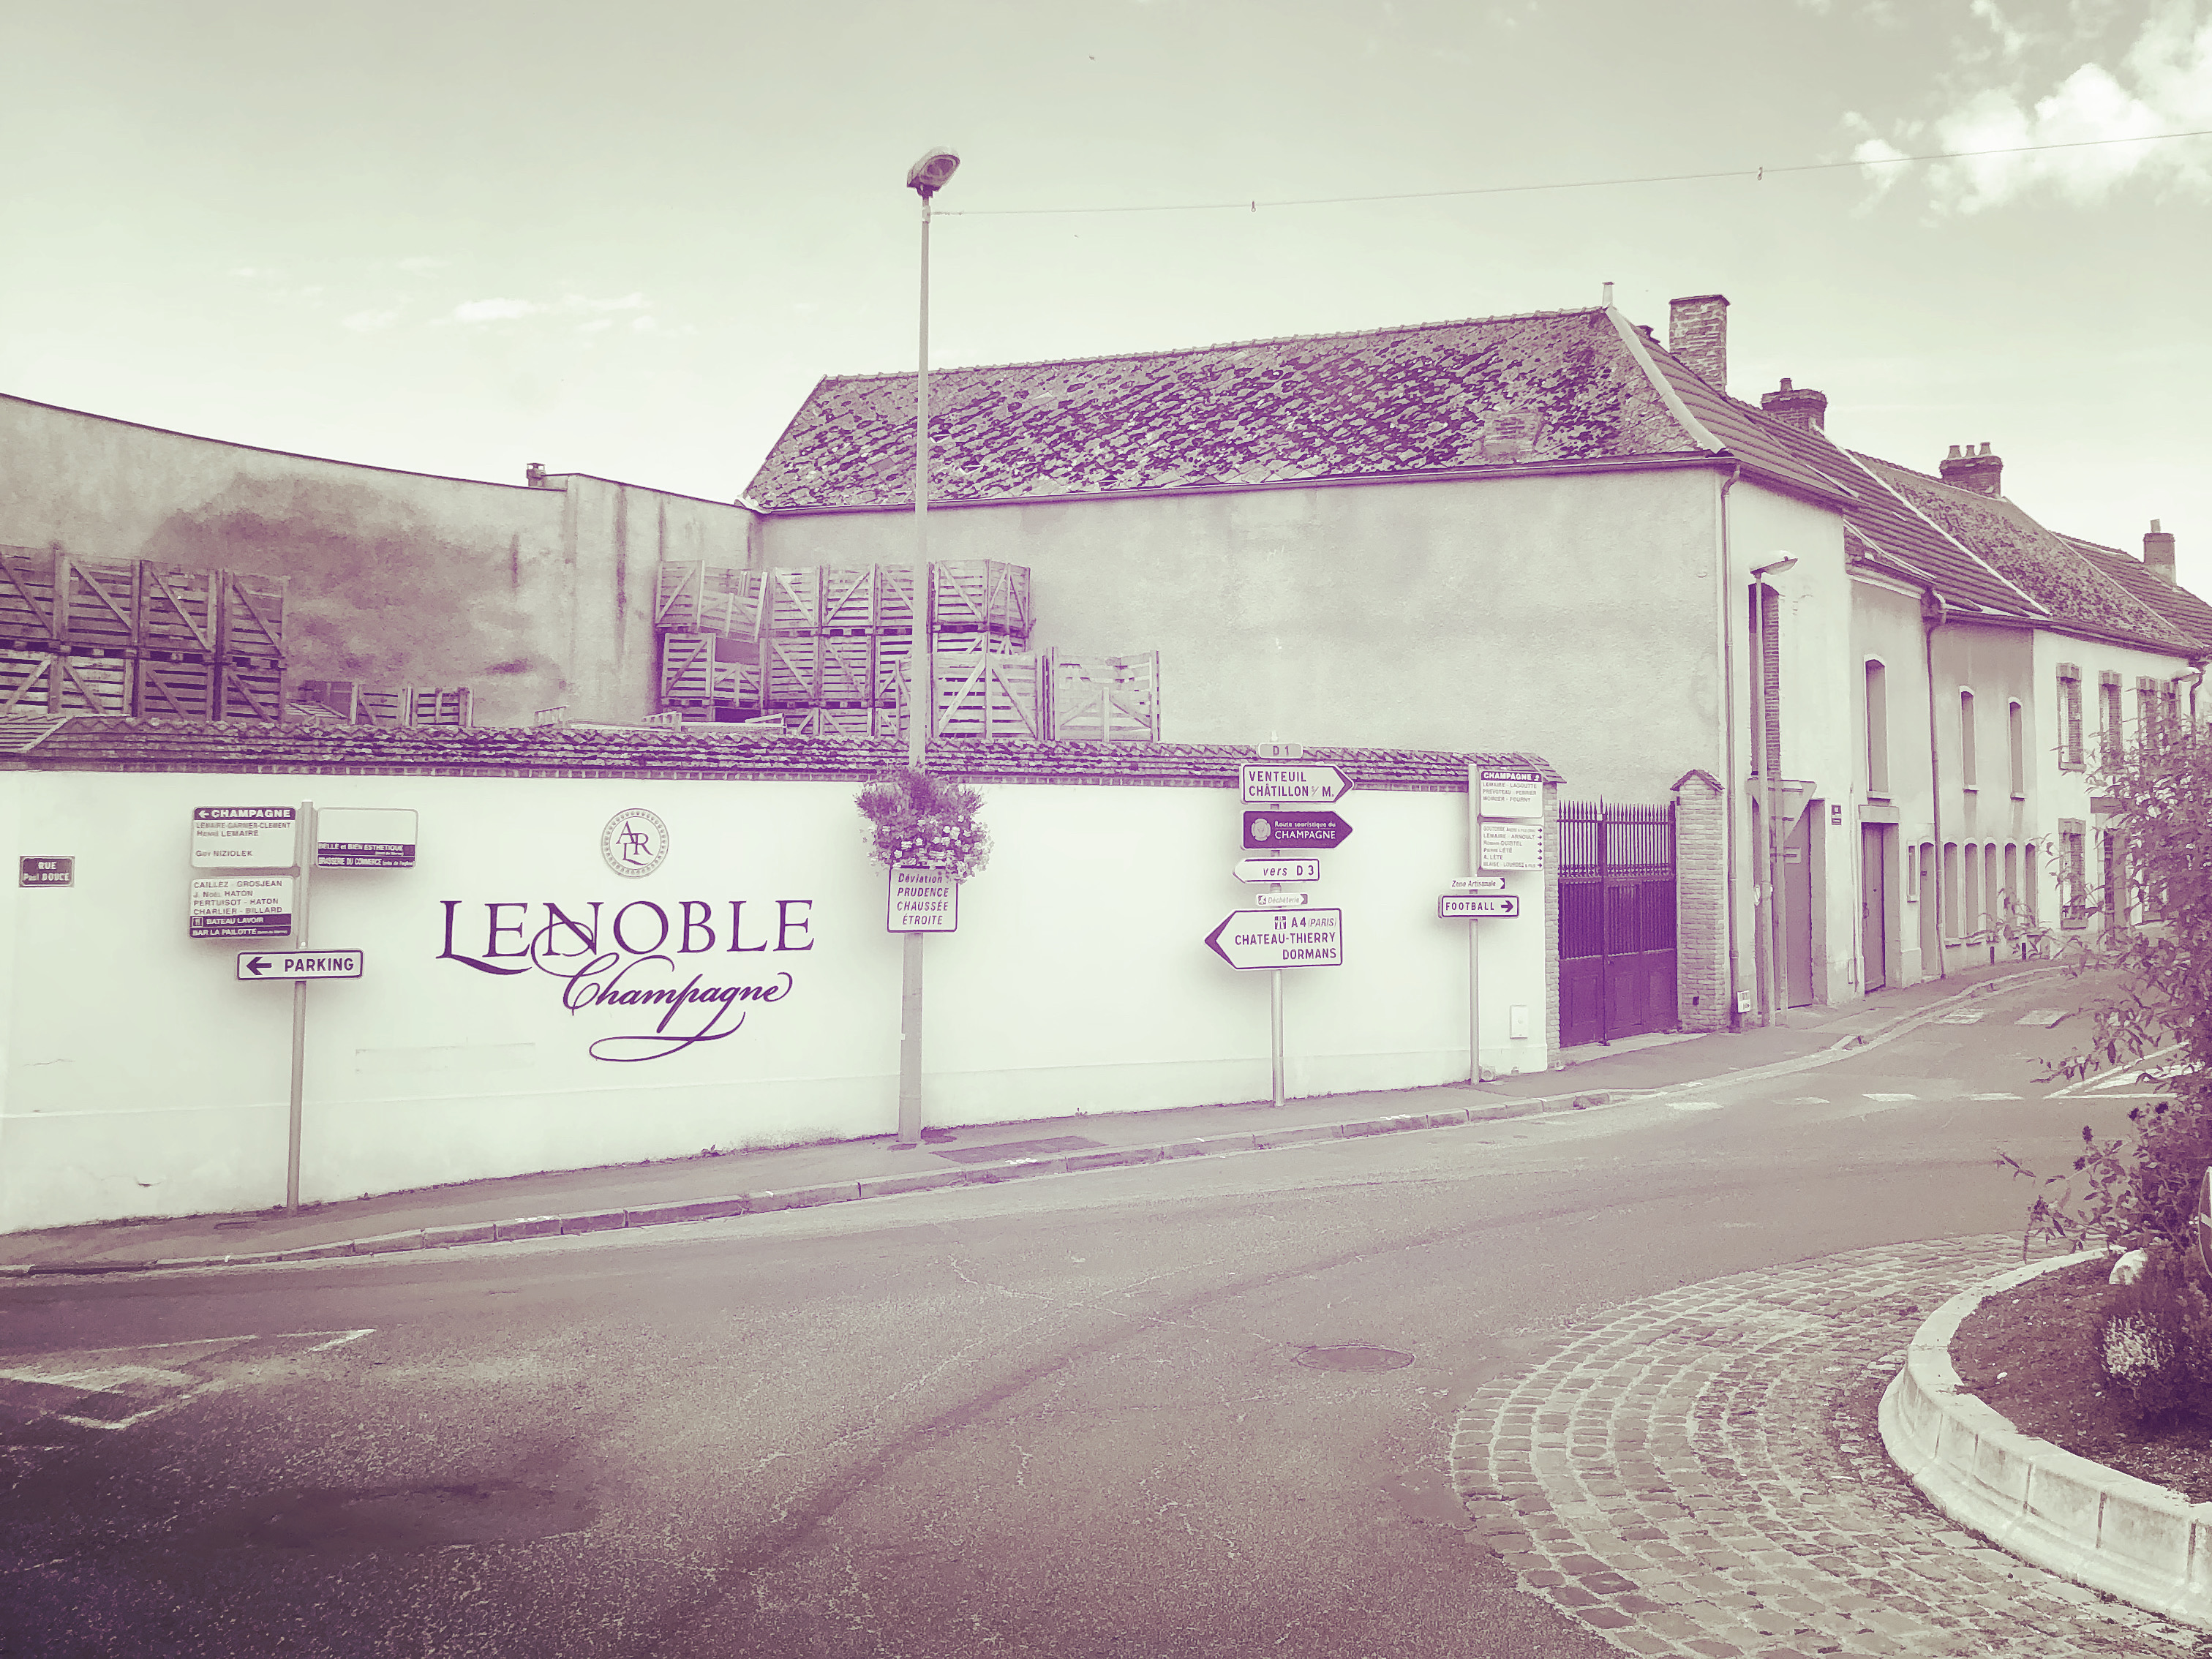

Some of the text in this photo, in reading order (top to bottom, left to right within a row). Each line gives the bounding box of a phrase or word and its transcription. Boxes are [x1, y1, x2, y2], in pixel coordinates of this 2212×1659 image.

[1273, 745, 1289, 756] D 1
[1249, 770, 1306, 782] VENTEUIL
[1483, 772, 1532, 780] CHAMPAGNE
[1249, 783, 1309, 797] CHÂTILLON
[1322, 786, 1334, 797] M.
[211, 809, 291, 819] CHAMPAGNE
[1294, 820, 1327, 829] touristique
[1274, 830, 1336, 840] CHAMPAGNE
[38, 861, 57, 870] RUE
[1263, 865, 1314, 876] vers D 3
[42, 873, 70, 881] DOUCE
[898, 873, 943, 884] Déviation
[897, 887, 949, 898] PRUDENCE
[897, 899, 949, 911] CHAUSSÉE
[1445, 902, 1494, 911] FOOTBALL
[902, 913, 943, 925] ÉTROITE
[1291, 917, 1337, 928] A 4 (PARIS)
[435, 900, 815, 975] LENOBLE
[1235, 931, 1336, 946] CHATEAU-THIERRY
[1282, 947, 1337, 960] DORMANS
[285, 958, 355, 972] PARKING
[541, 939, 793, 1062] Champagne
